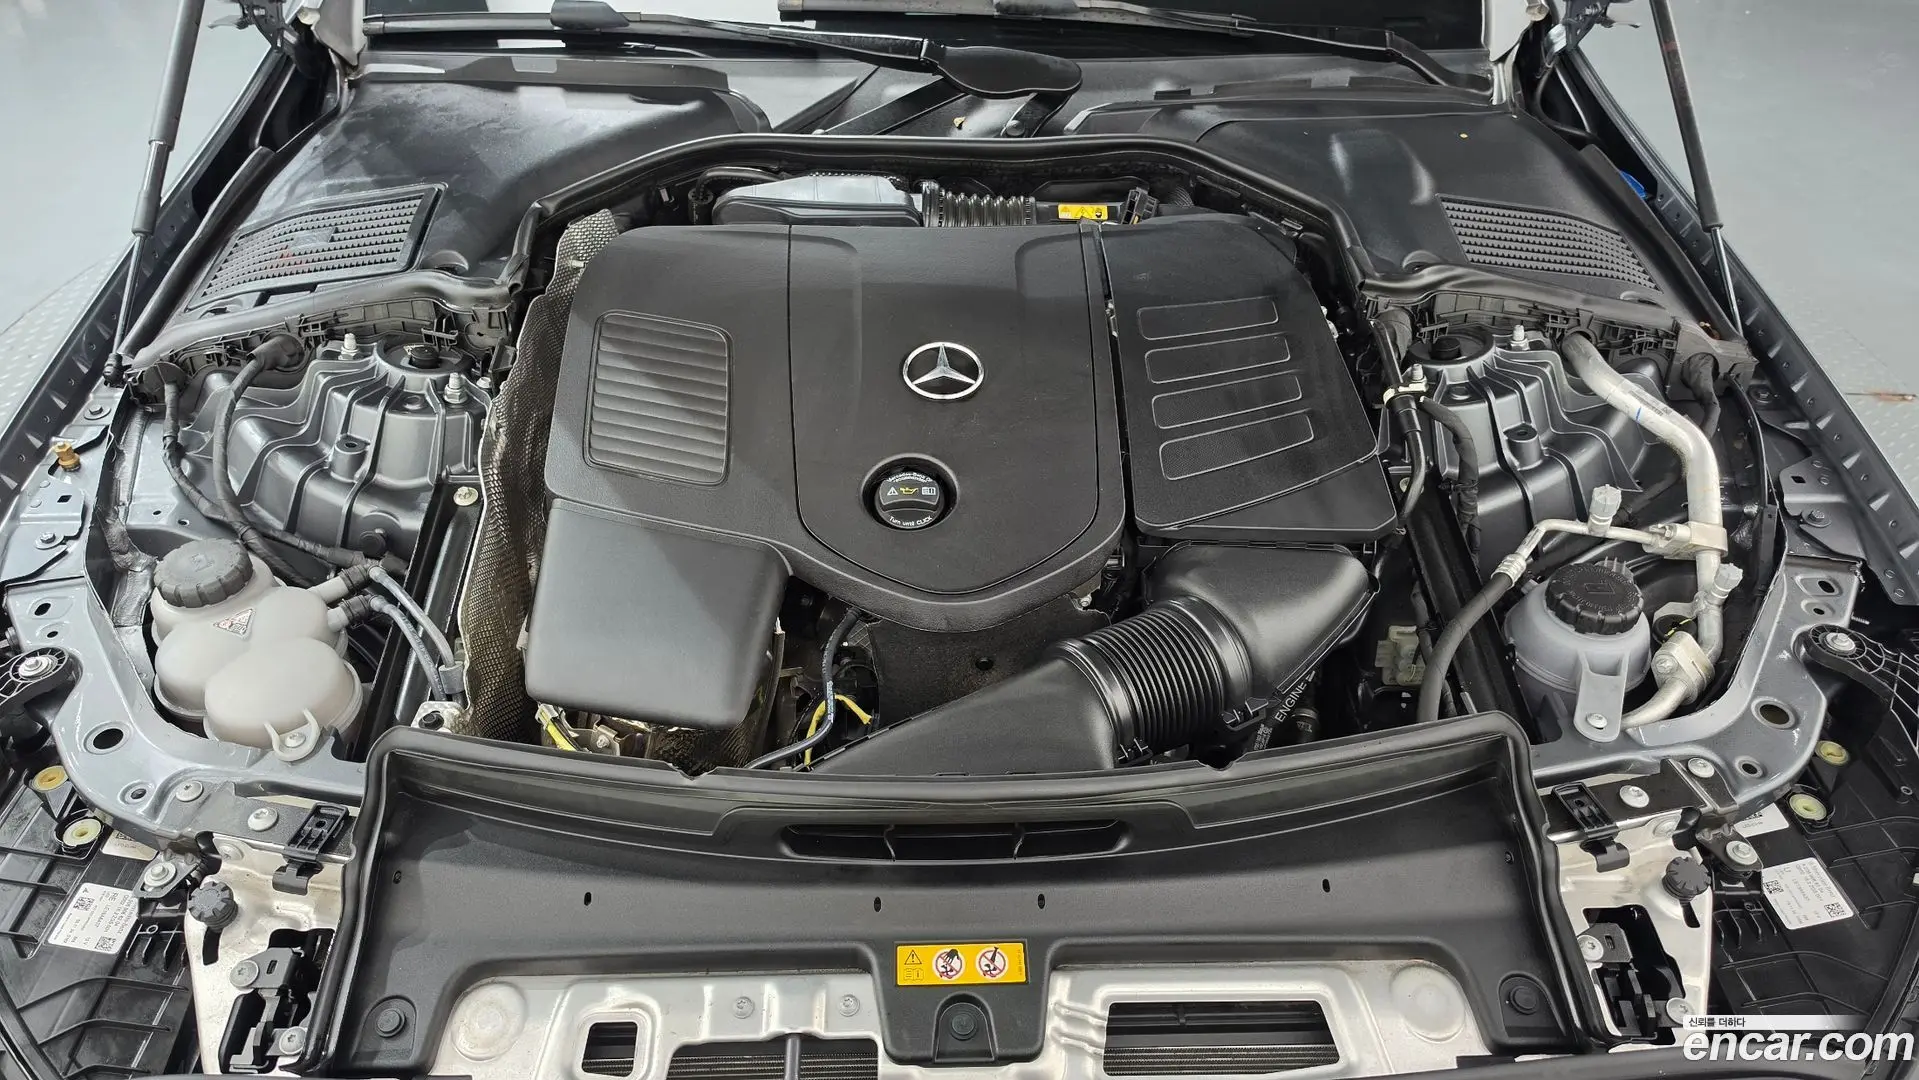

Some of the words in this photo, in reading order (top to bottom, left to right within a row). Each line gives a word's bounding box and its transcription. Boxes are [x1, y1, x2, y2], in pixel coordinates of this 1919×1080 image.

[889, 515, 901, 525] Turn
[916, 515, 933, 526] CLICK
[1274, 682, 1308, 723] ENGINE
